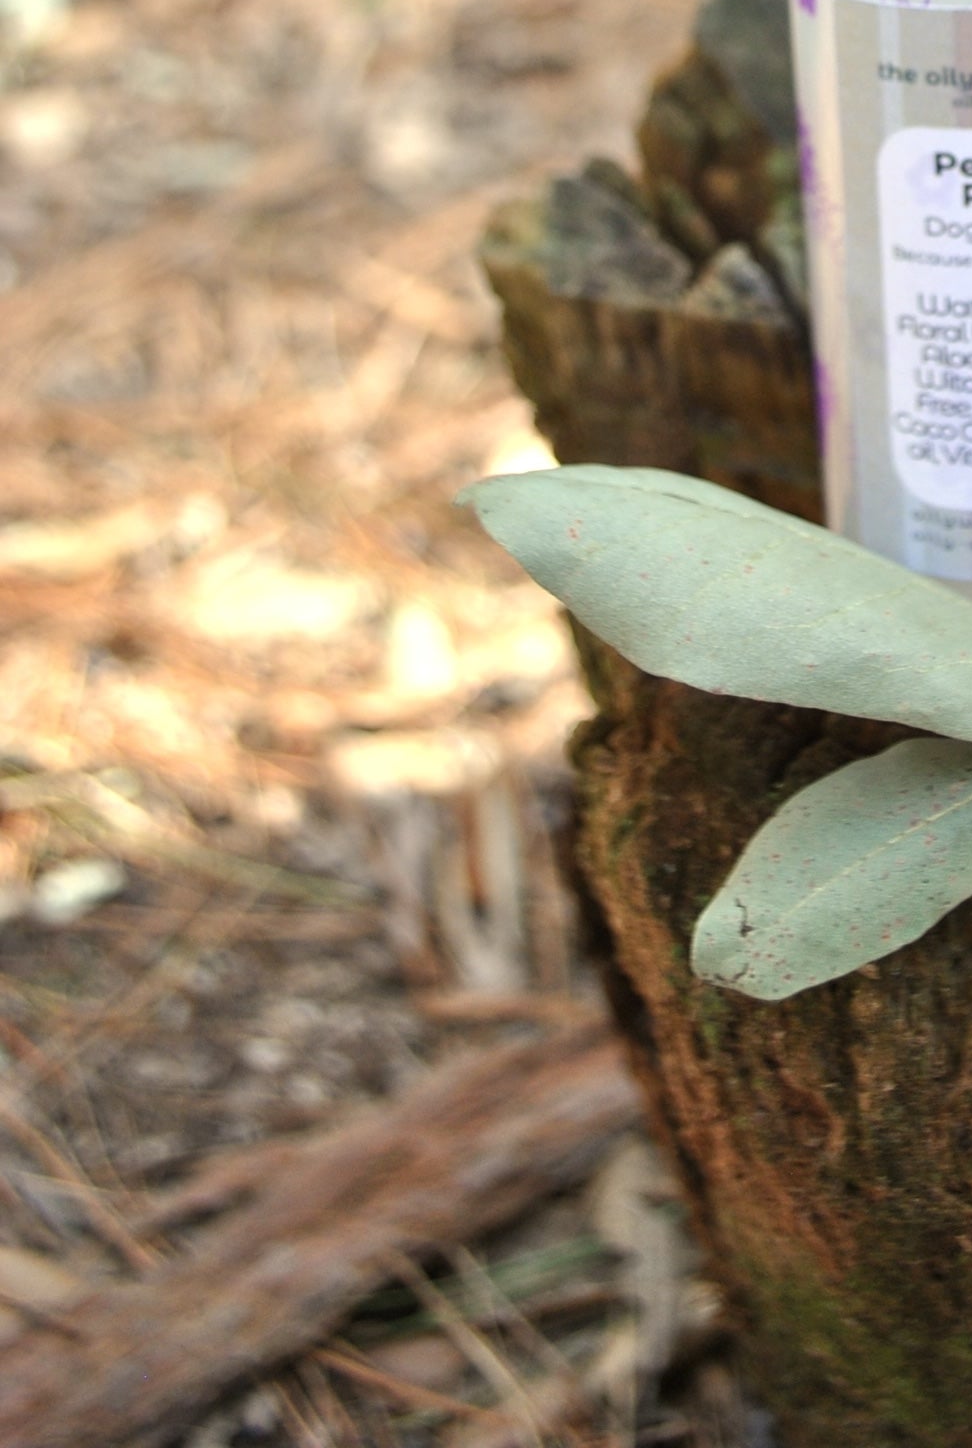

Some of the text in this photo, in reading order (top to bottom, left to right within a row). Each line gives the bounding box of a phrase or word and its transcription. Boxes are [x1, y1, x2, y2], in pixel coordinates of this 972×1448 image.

[878, 63, 917, 84] the
[897, 314, 970, 343] Floral
[895, 411, 958, 440] Coco
